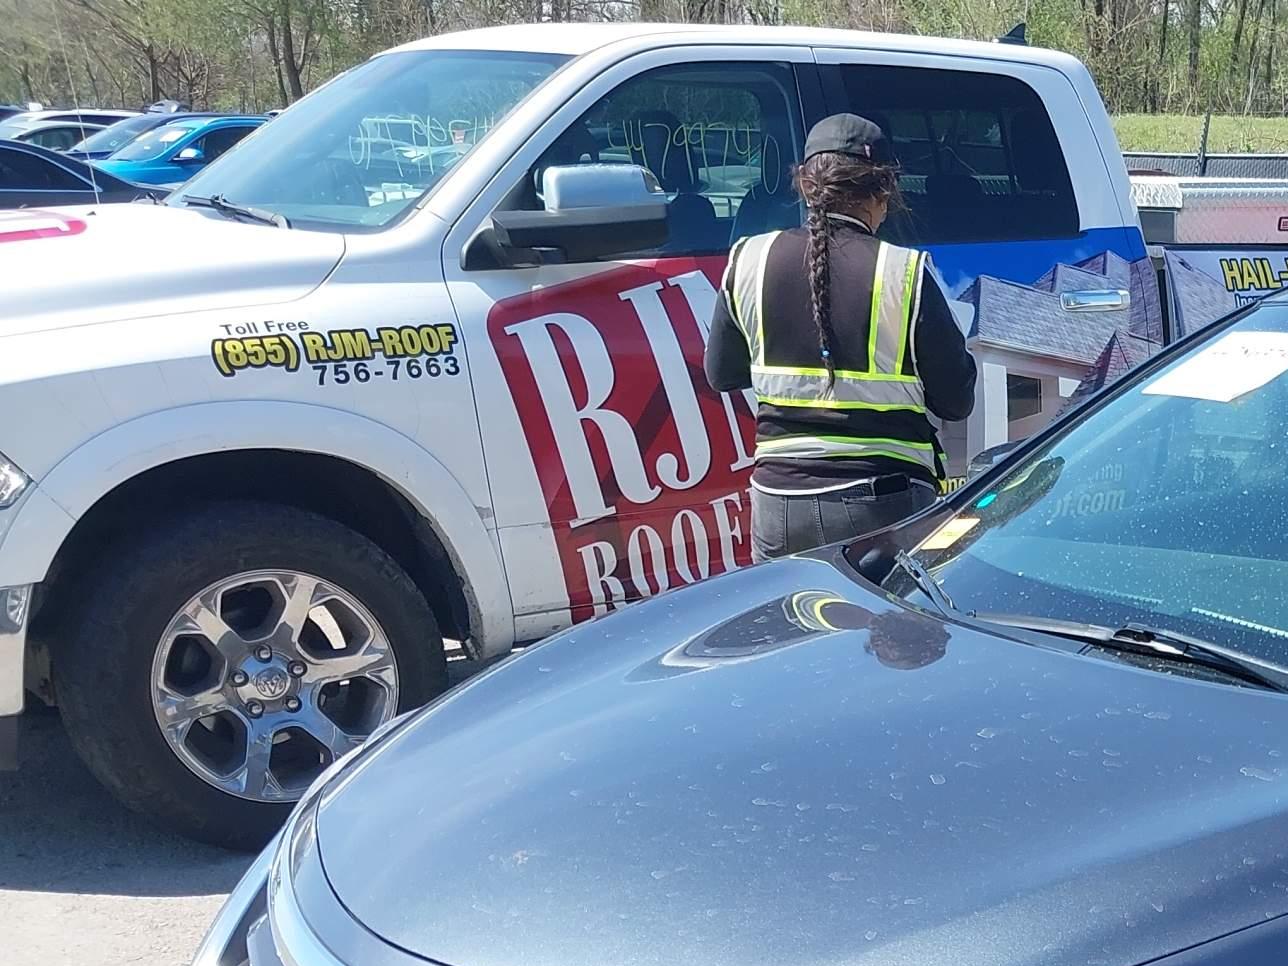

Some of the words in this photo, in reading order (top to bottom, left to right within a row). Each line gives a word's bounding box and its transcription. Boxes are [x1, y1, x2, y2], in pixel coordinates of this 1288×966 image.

[220, 323, 259, 336] Toll
[264, 320, 310, 333] Free
[211, 333, 300, 377] (855)
[300, 324, 458, 363] RJM-ROOF
[312, 356, 461, 386] 756-7663
[577, 490, 752, 619] ROOF
